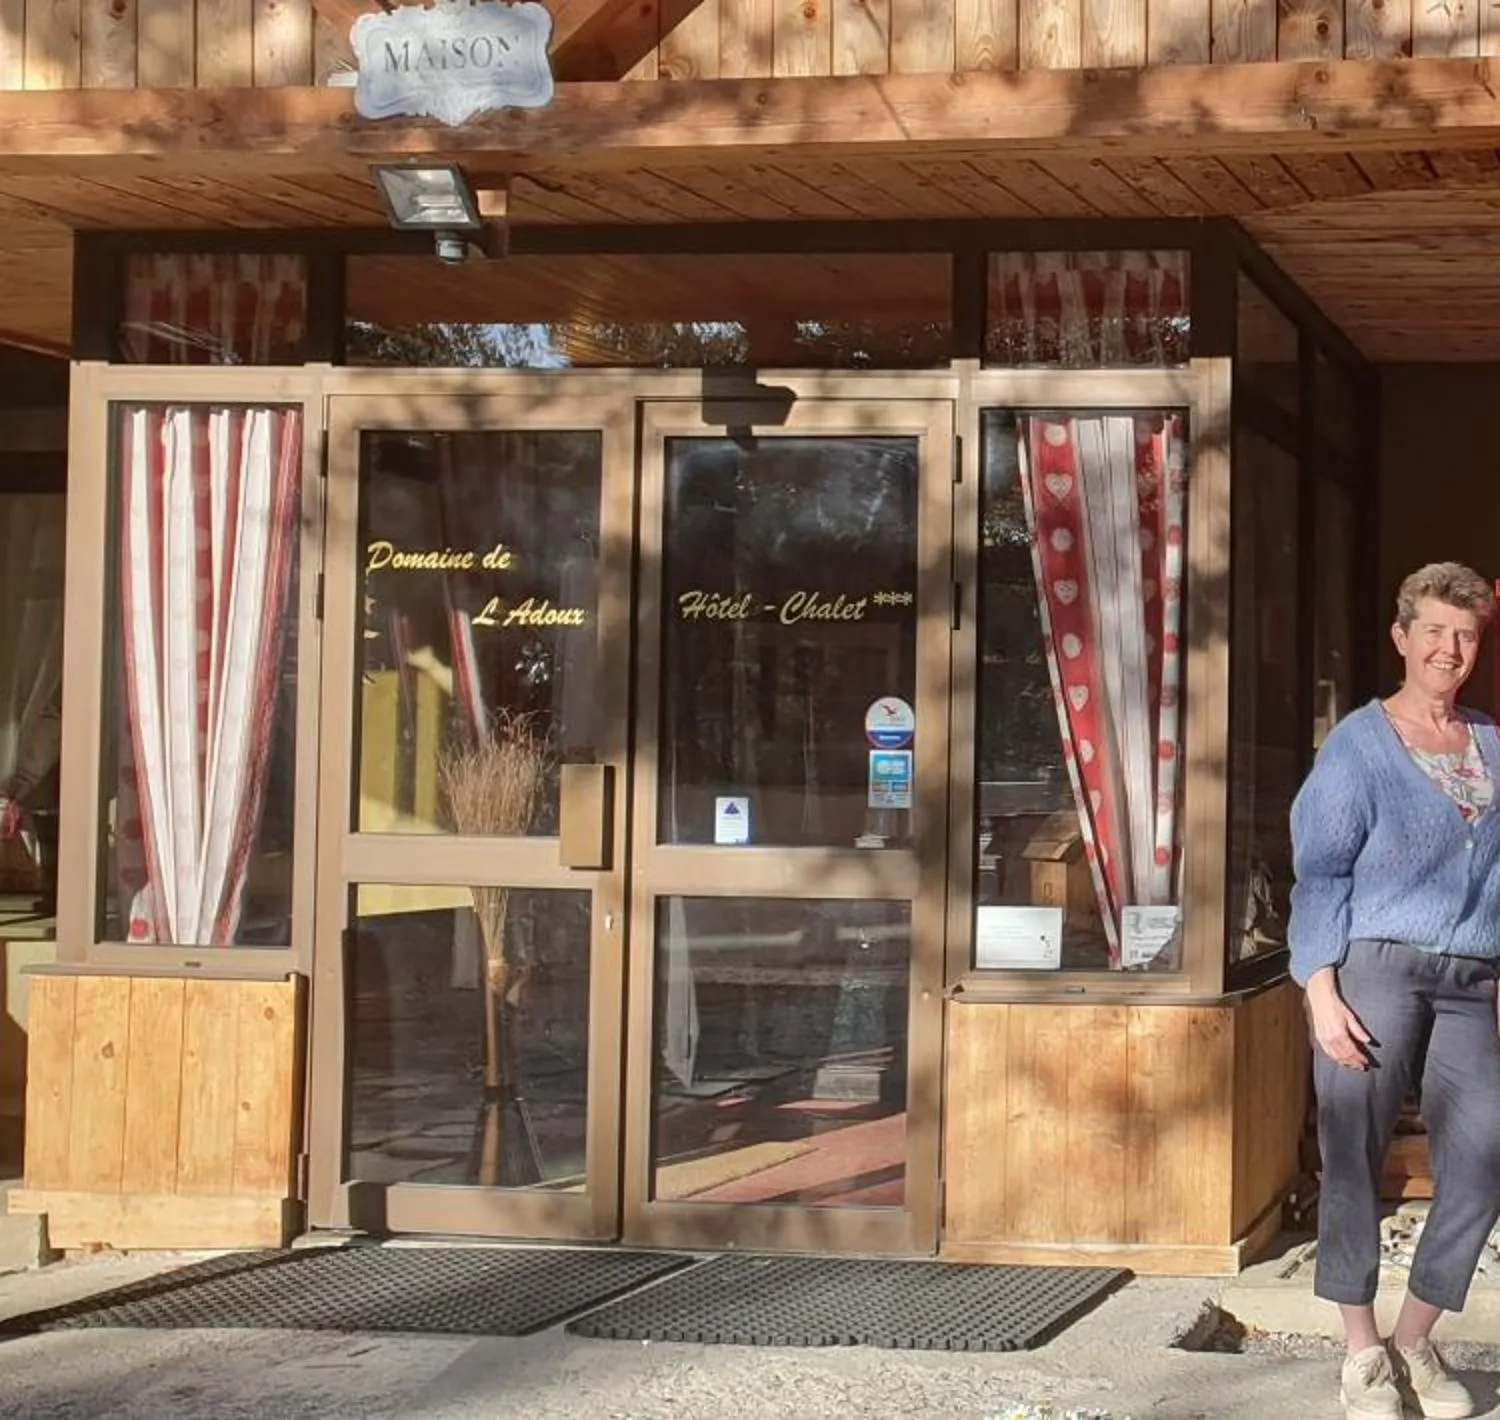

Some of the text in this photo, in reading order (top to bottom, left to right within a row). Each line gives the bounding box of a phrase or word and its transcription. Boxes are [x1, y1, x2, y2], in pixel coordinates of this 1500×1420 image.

[384, 36, 520, 72] MAISON
[366, 541, 511, 576] Domaine de
[502, 597, 585, 627] Adoux
[679, 590, 752, 620] Hôtel
